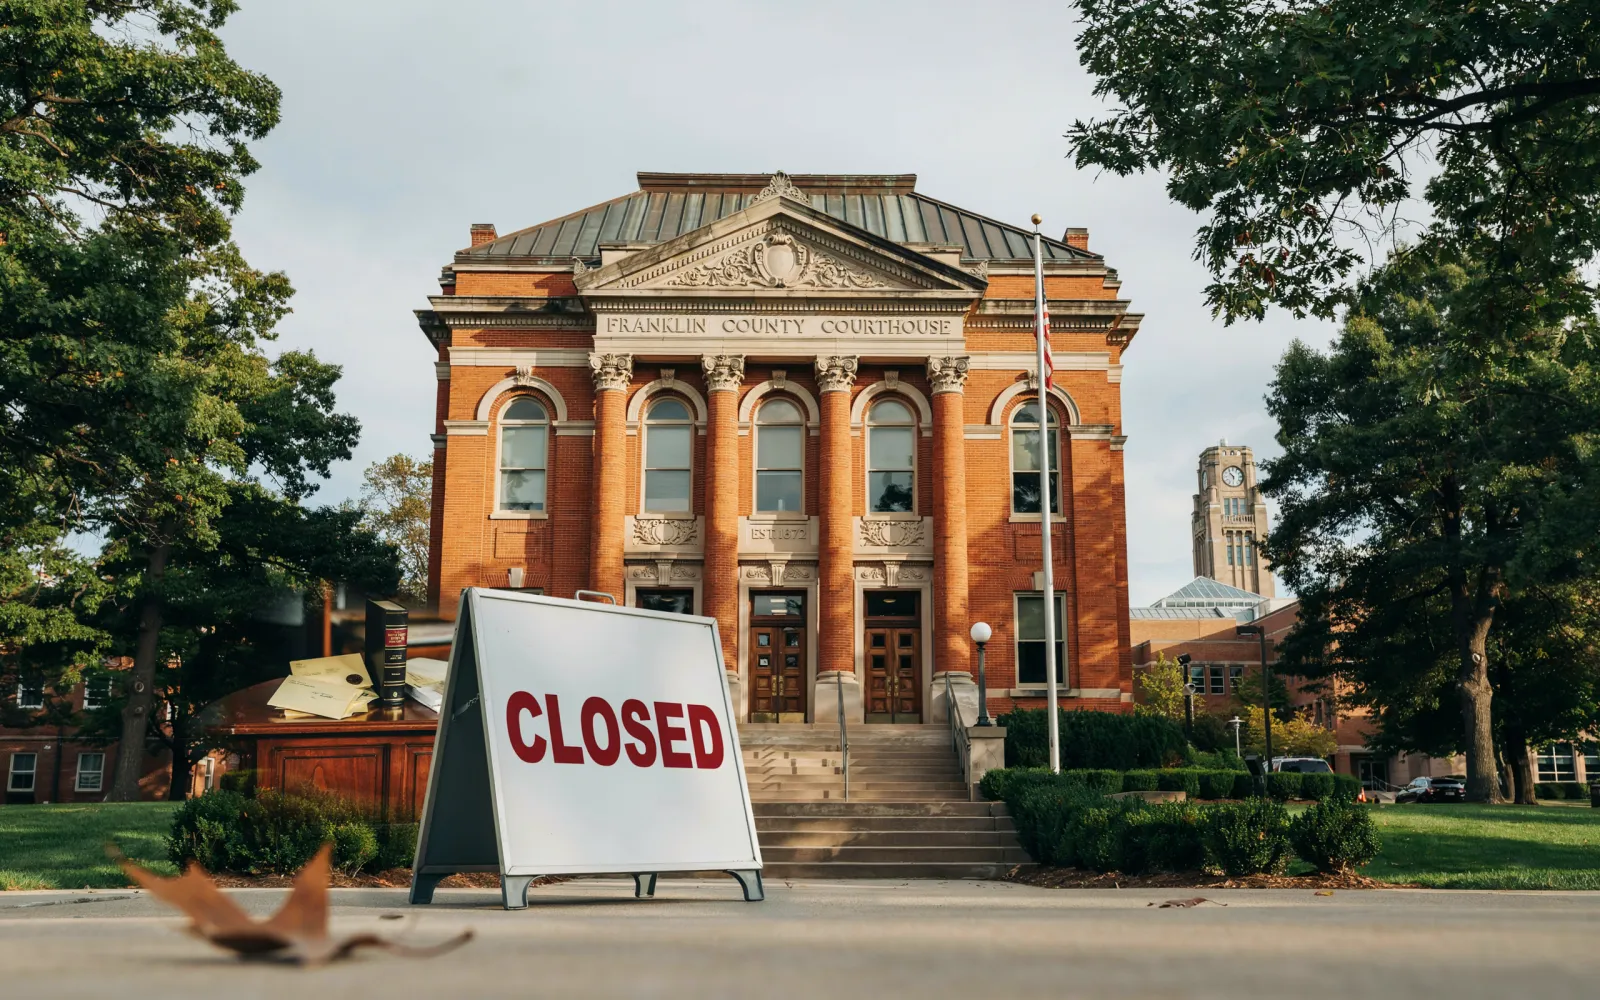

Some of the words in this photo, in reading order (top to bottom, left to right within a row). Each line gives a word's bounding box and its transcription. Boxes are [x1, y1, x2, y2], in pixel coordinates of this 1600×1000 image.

[606, 317, 706, 333] FRANKLIN
[721, 318, 805, 334] COUNTY
[821, 319, 951, 335] COURTHOUSE
[506, 690, 724, 769] CLOSED
